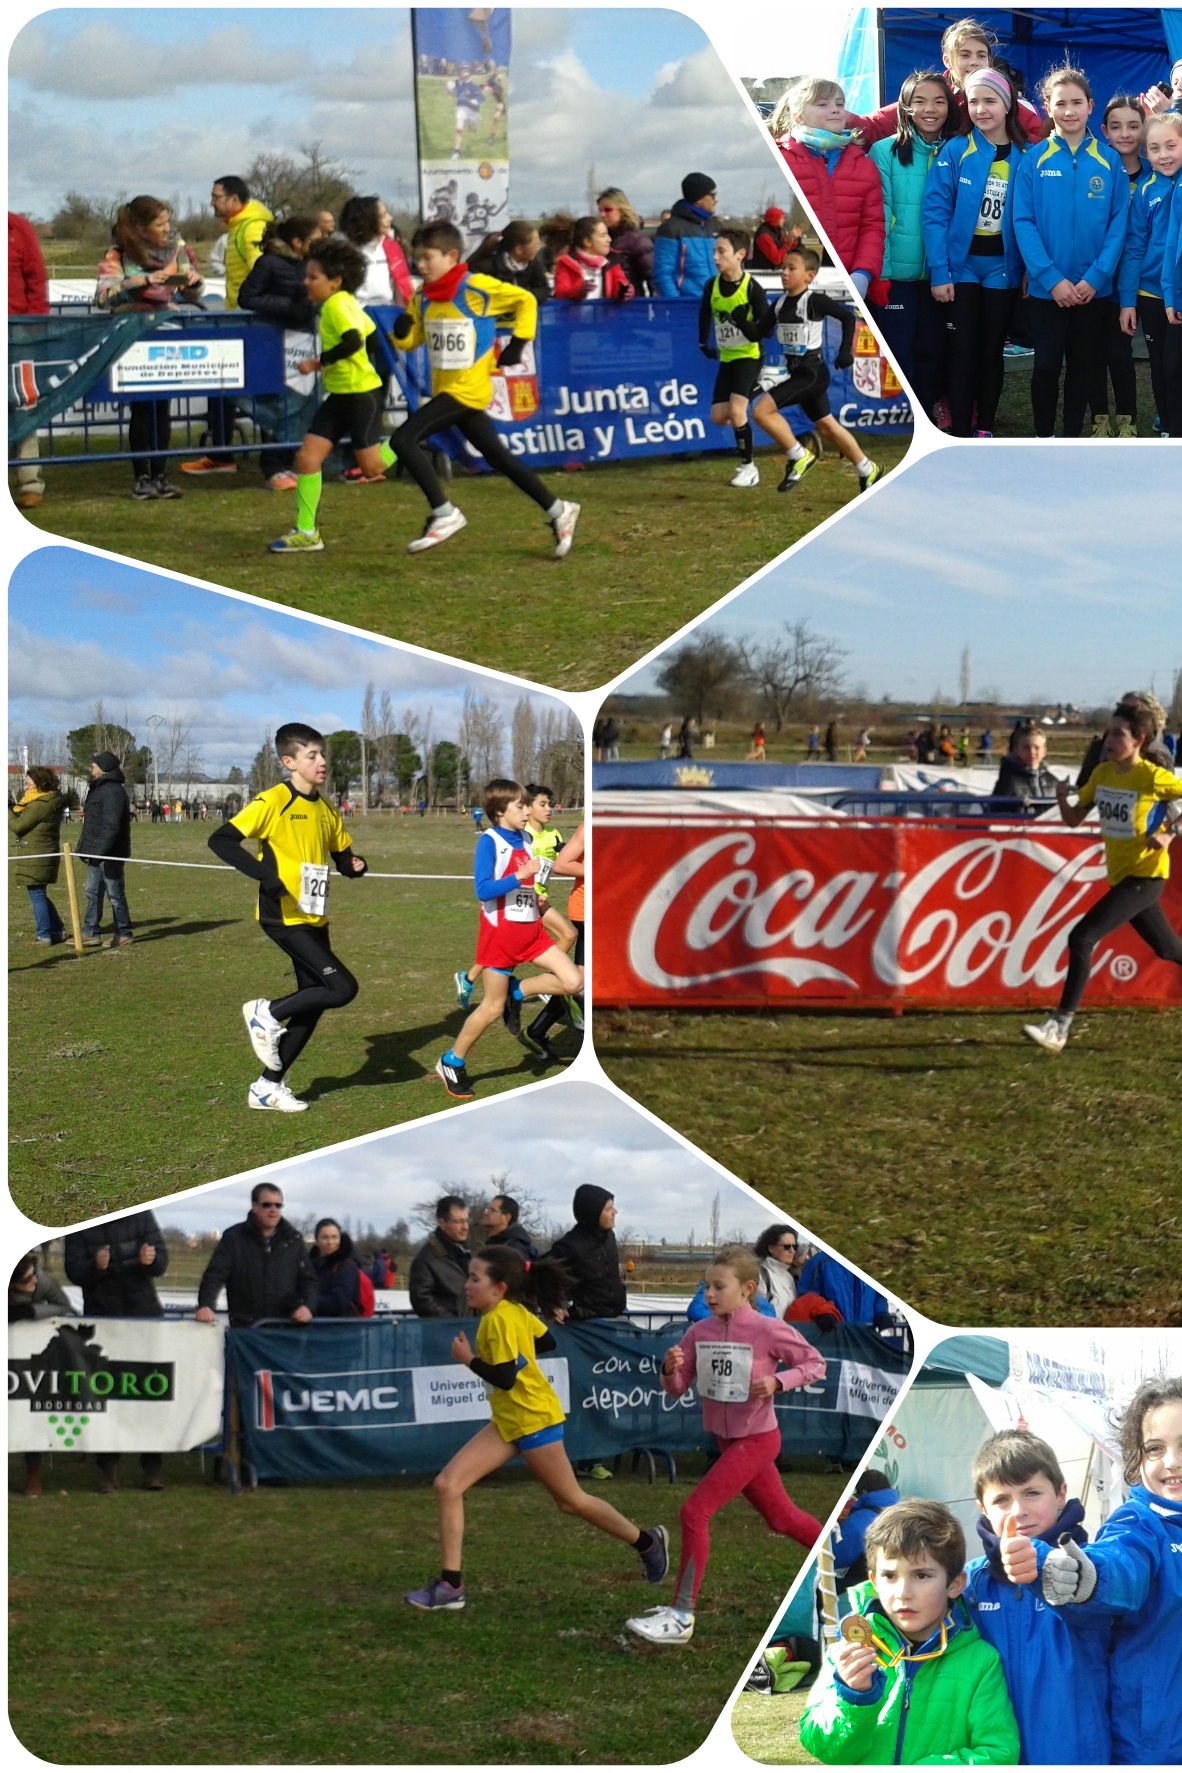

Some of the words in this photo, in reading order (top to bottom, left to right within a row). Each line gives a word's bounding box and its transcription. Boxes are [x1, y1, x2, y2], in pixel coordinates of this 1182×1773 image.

[981, 197, 1006, 220] 08
[553, 383, 650, 416] Junta
[659, 378, 699, 406] de
[593, 425, 615, 457] y
[624, 412, 706, 445] León
[592, 1355, 631, 1375] con
[638, 1354, 657, 1375] el
[35, 1401, 102, 1411] BODEGAS
[282, 1386, 399, 1413] UEMC
[431, 1393, 471, 1408] Miguel
[582, 1384, 697, 1419] deporte
